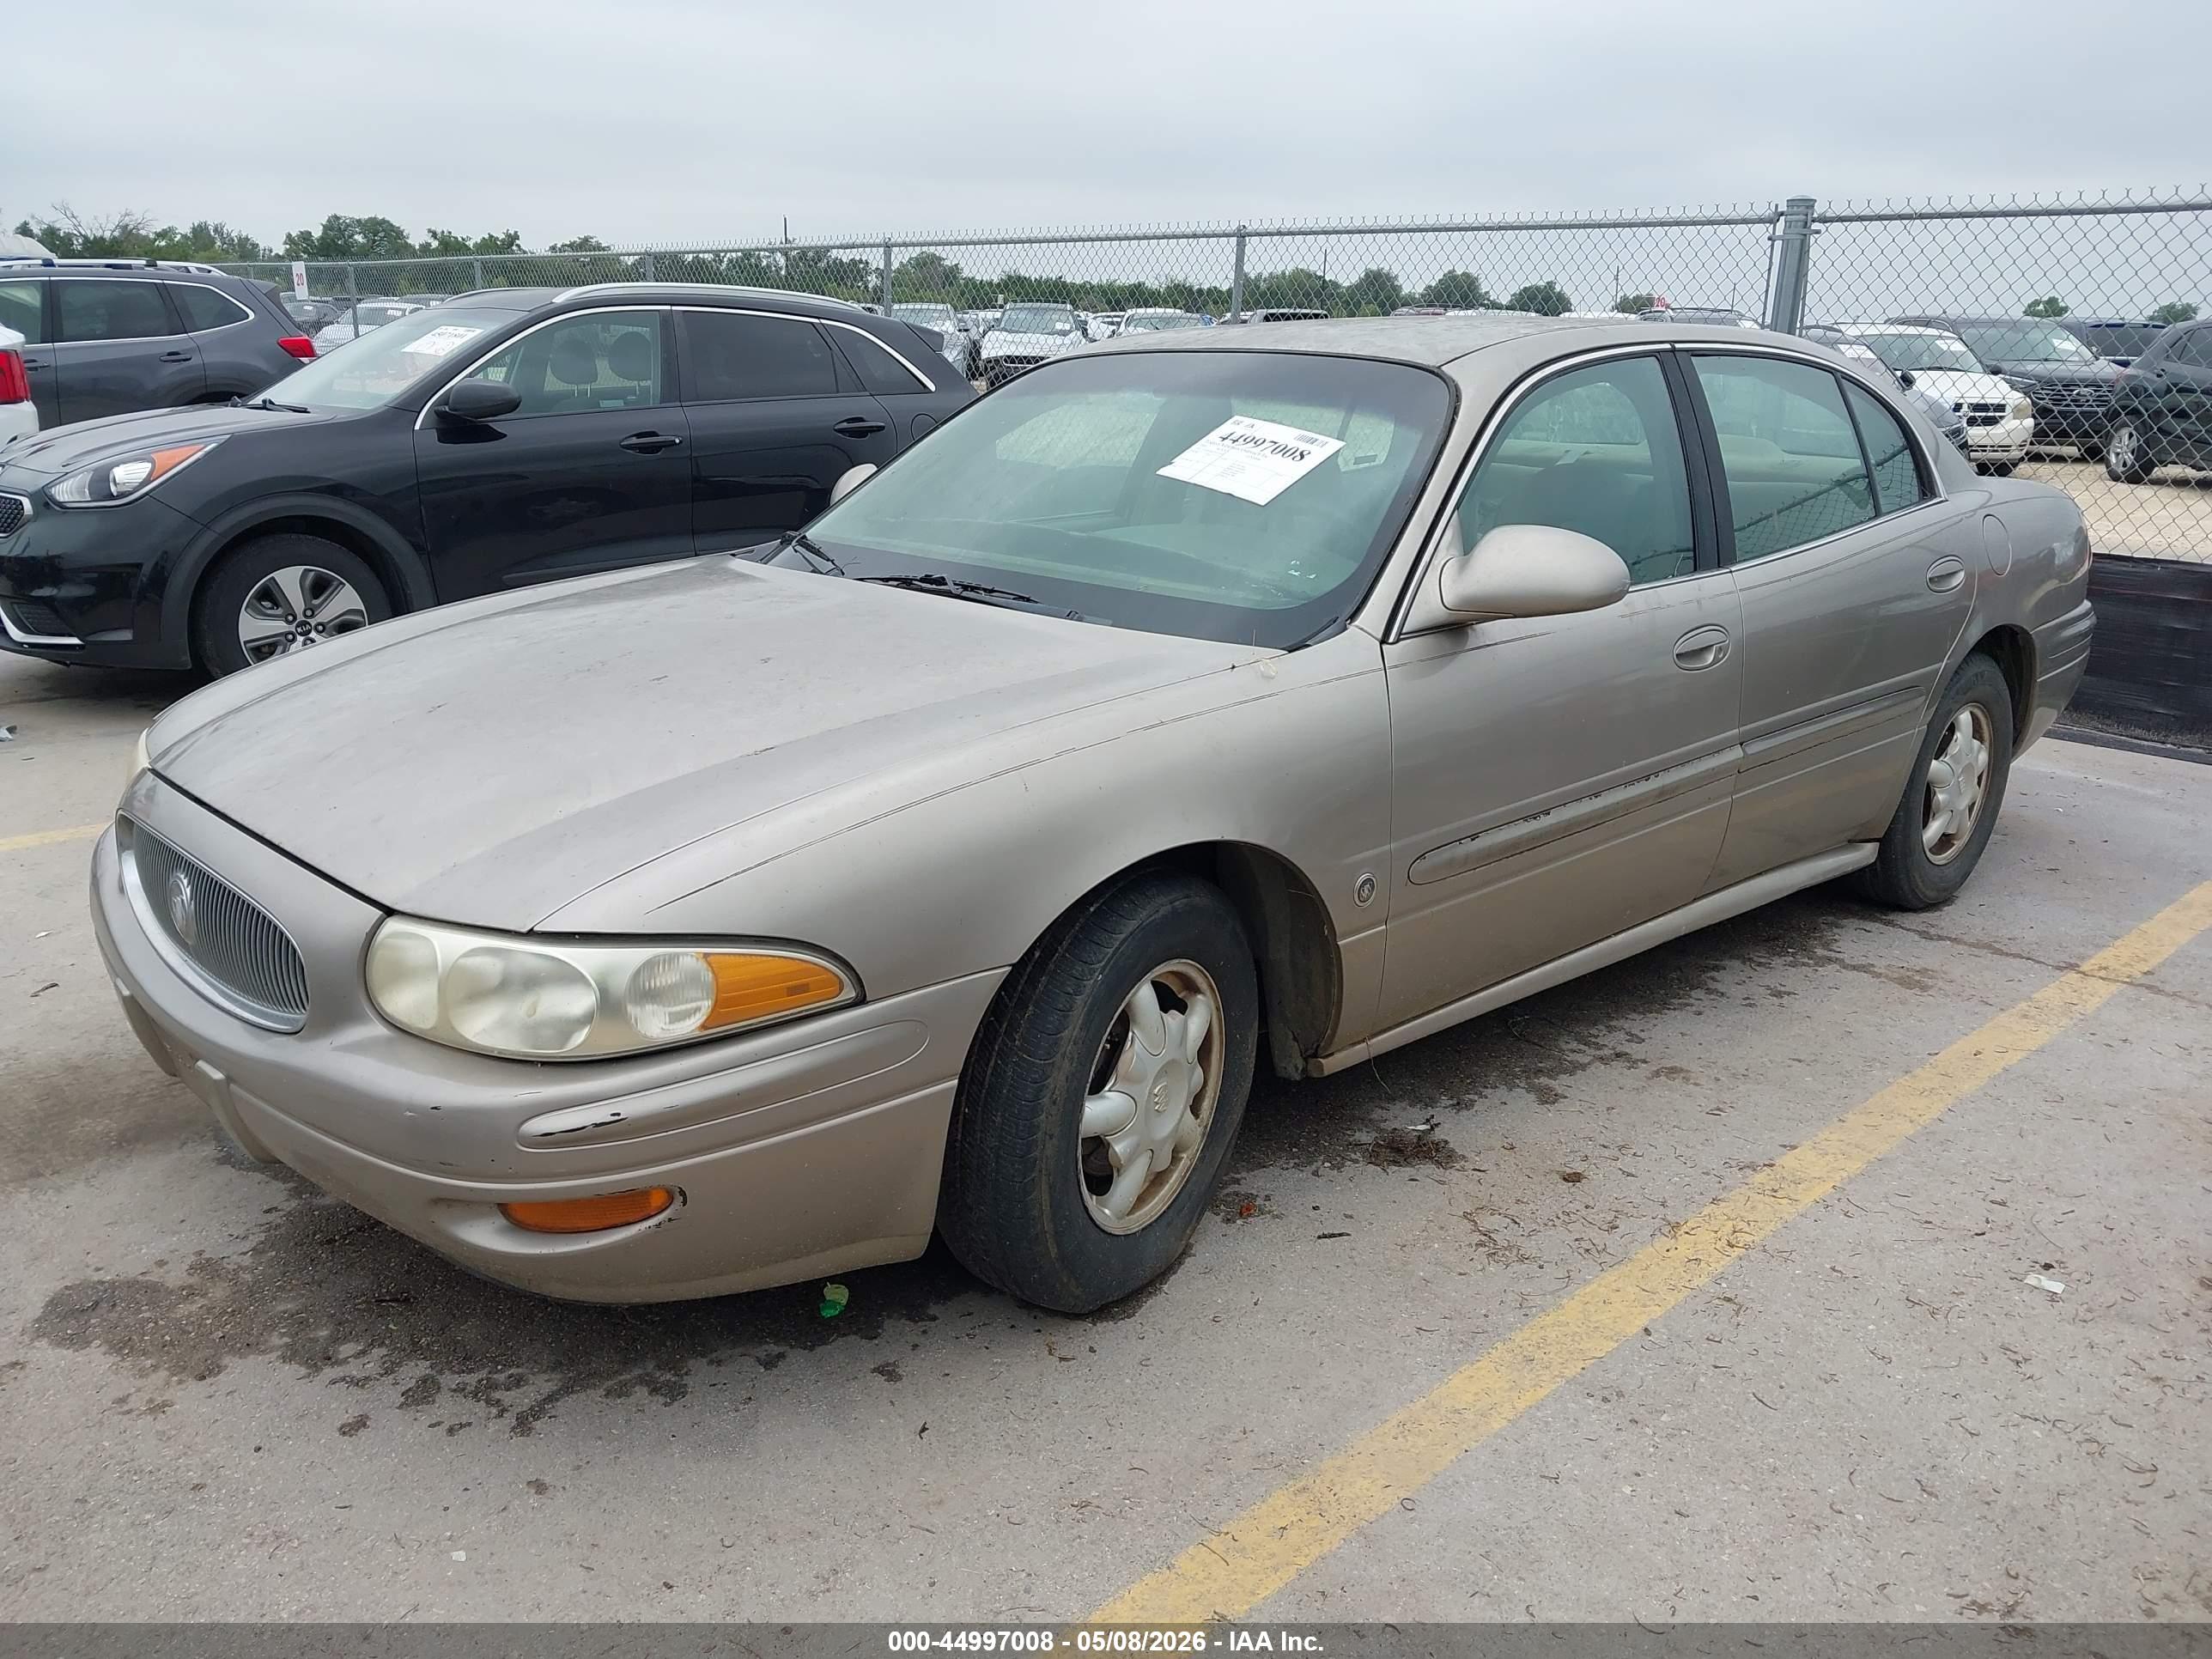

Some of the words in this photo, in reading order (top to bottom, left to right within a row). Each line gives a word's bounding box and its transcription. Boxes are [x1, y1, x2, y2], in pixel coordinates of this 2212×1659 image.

[295, 272, 305, 287] 20
[1218, 431, 1311, 462] 44997008
[296, 623, 312, 634] KIA
